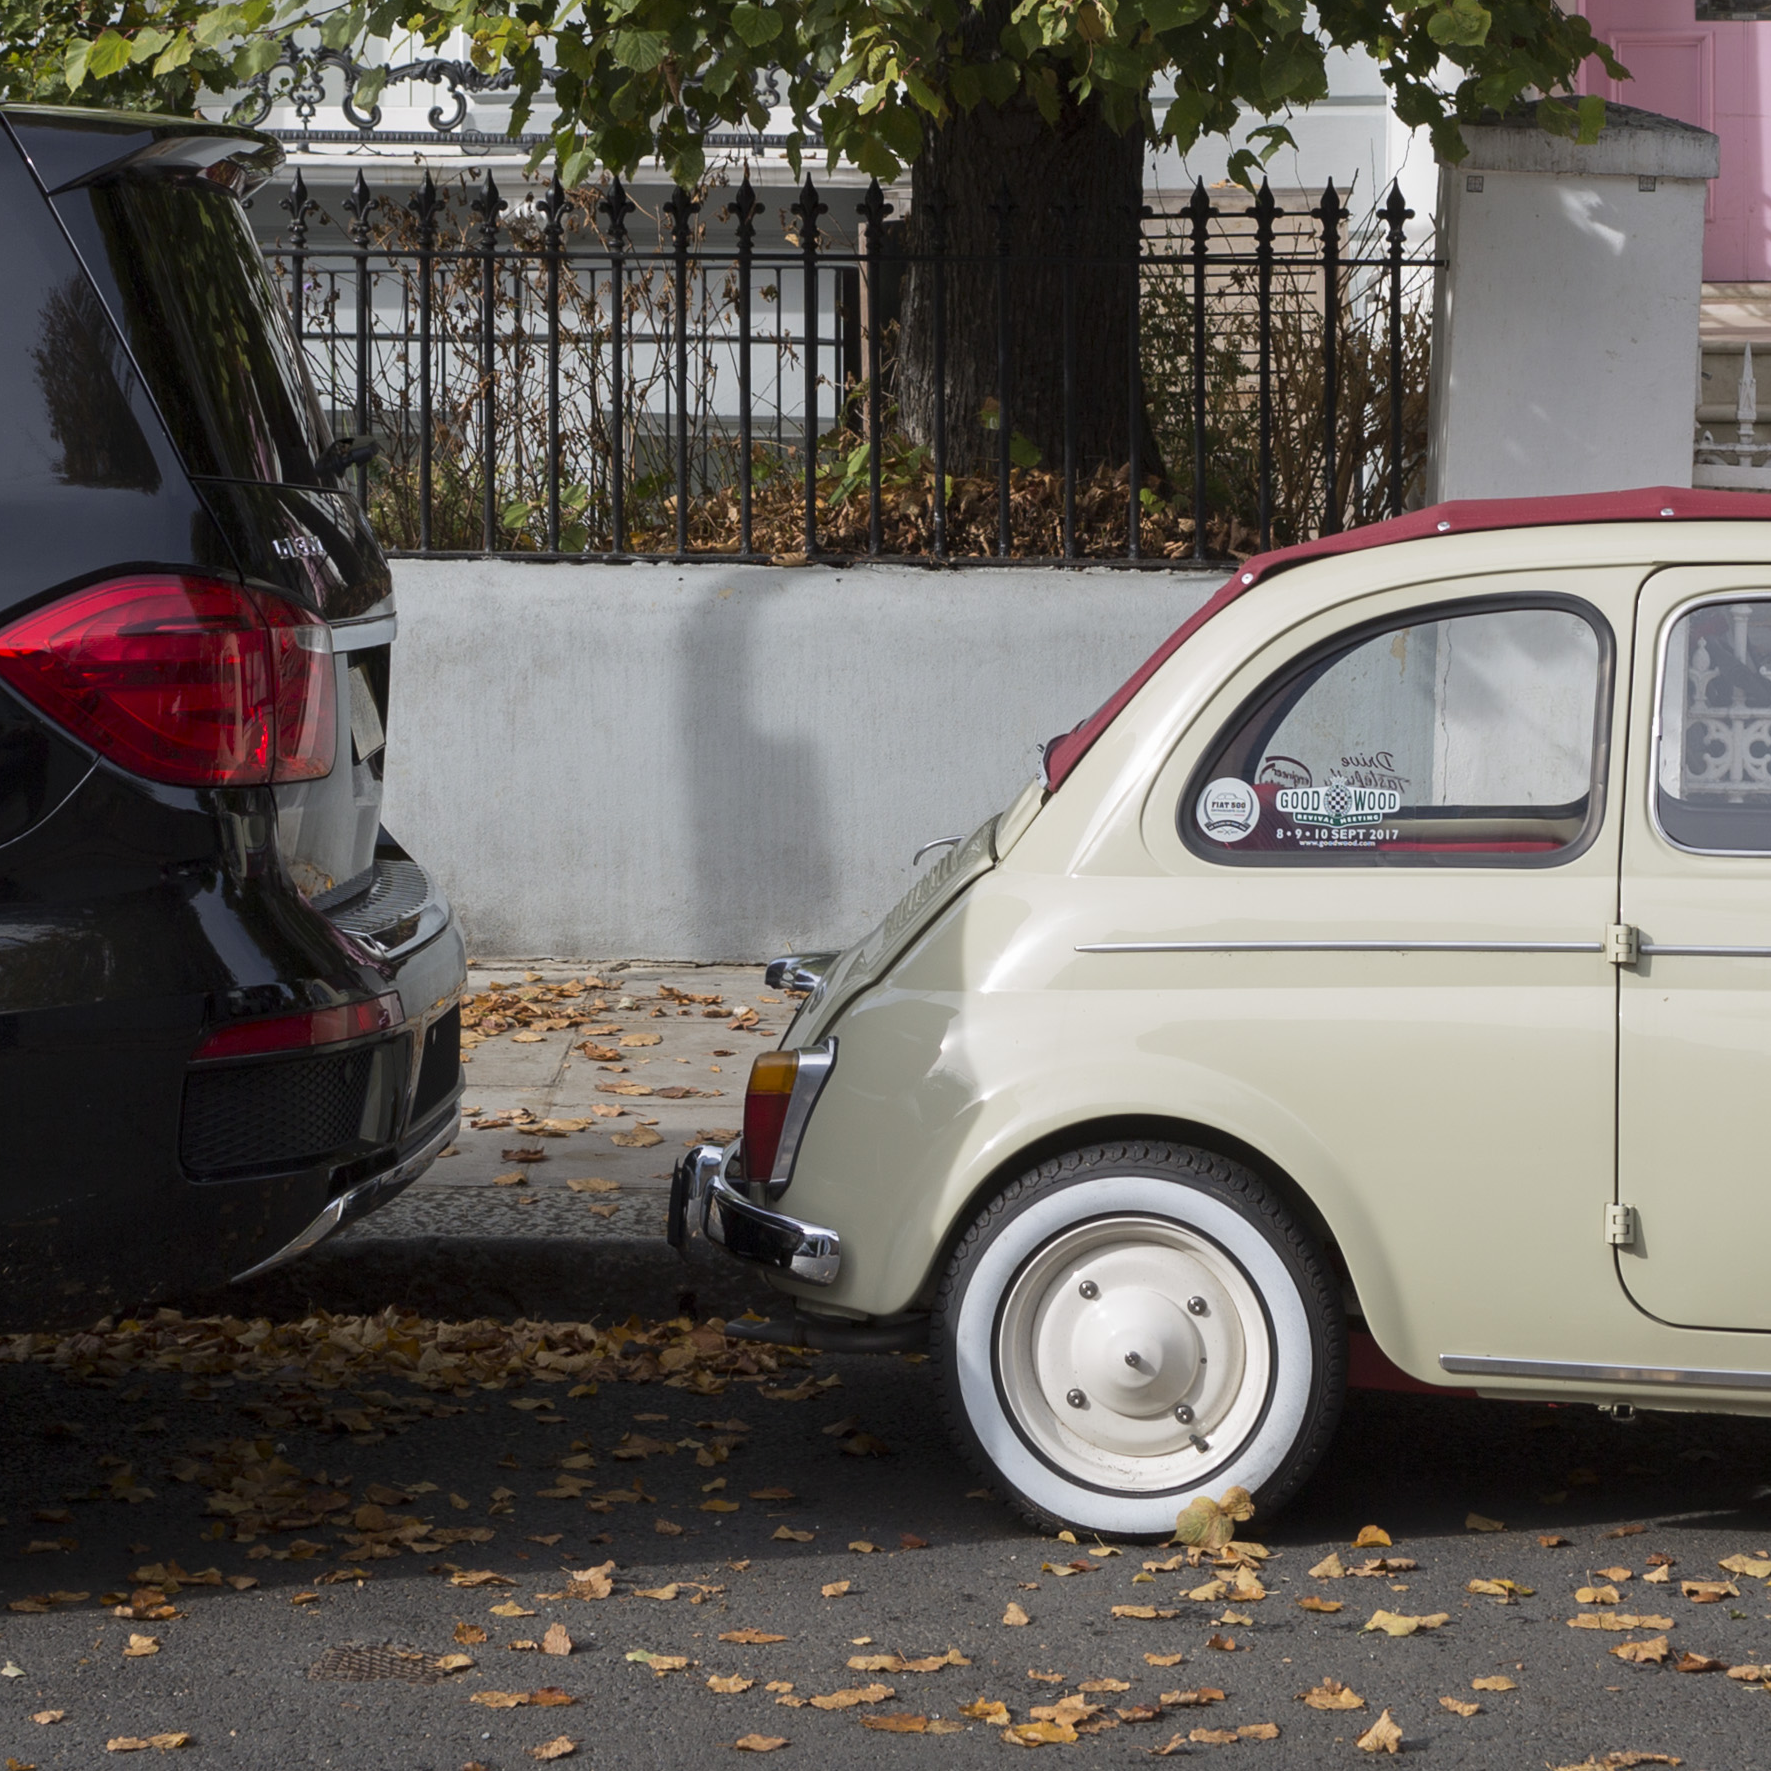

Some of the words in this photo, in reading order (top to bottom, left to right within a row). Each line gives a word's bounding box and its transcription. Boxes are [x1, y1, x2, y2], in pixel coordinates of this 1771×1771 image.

[1280, 790, 1320, 811] GOOD
[1354, 790, 1397, 811] WOOD
[1297, 814, 1334, 824] REVIVAL
[1340, 815, 1378, 824] MEETING
[1276, 828, 1283, 839] 8
[1295, 829, 1302, 839] 9
[1315, 829, 1328, 839] 10
[1331, 829, 1366, 840] SEPT
[1370, 829, 1399, 840] 2017
[1299, 840, 1376, 848] www.goodwood.com
